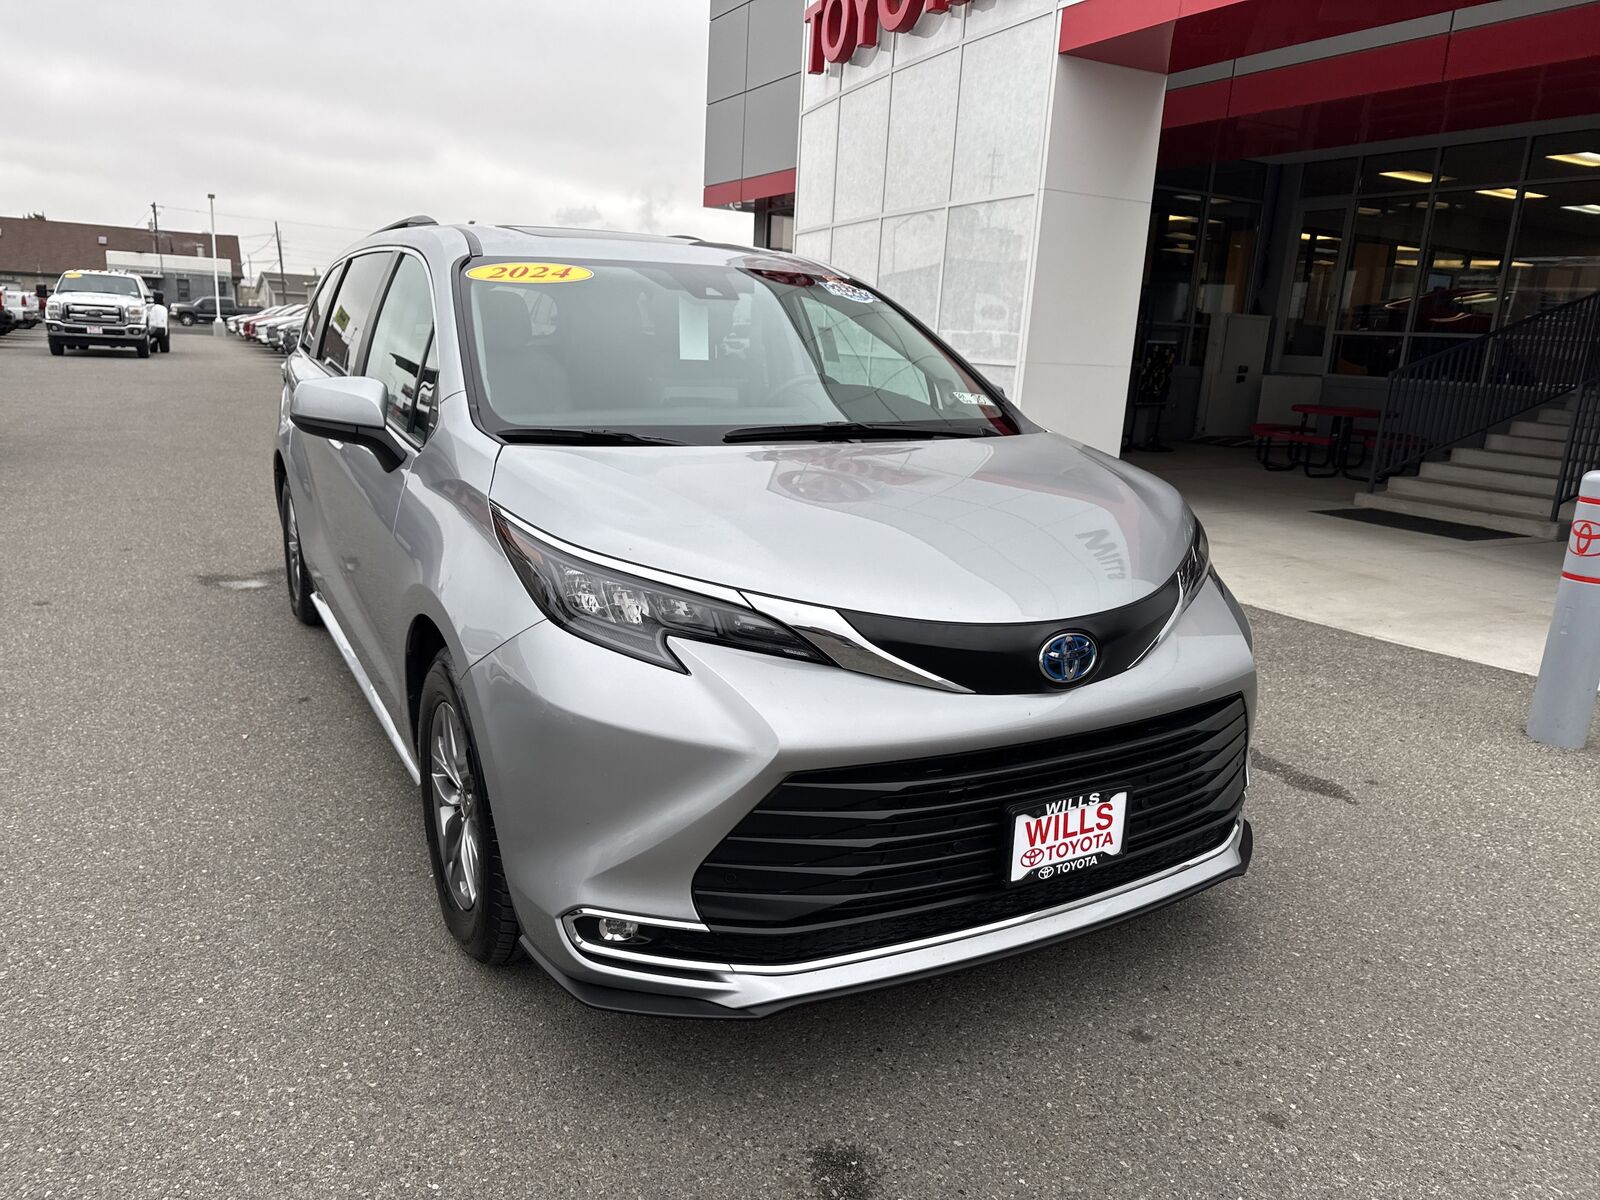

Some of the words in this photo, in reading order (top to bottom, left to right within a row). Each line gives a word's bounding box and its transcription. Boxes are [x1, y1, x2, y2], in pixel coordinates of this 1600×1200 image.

[486, 266, 572, 279] 2024
[1045, 793, 1100, 815] WILLS
[1025, 803, 1113, 847] WILLS
[1046, 832, 1113, 860] TOYOTA
[1056, 855, 1098, 874] TOYOTA
